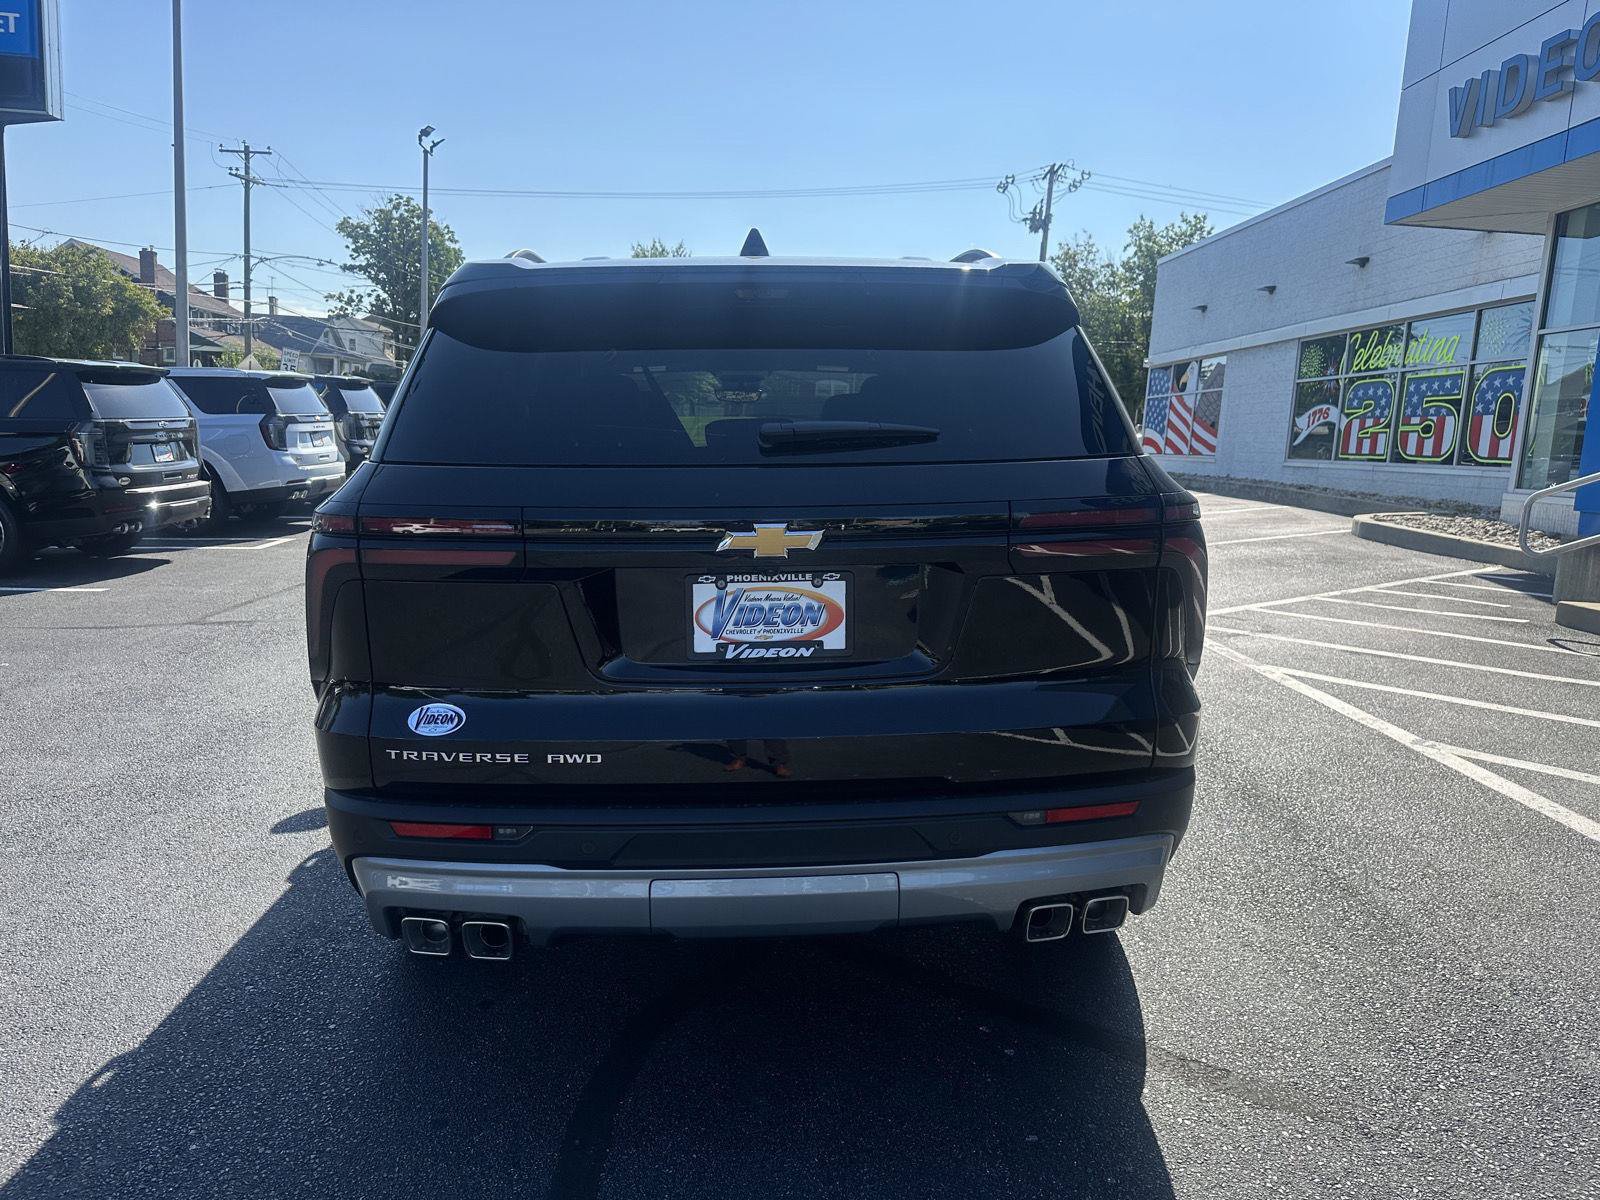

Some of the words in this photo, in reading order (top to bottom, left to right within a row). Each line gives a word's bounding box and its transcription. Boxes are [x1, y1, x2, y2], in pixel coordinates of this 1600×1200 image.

[1339, 329, 1461, 380] Celebrating
[1306, 406, 1330, 430] 1776
[1338, 365, 1527, 464] 250
[726, 573, 813, 582] PHOENIXVILLE
[763, 593, 782, 602] Means
[711, 587, 825, 640] VIDEON
[762, 627, 804, 635] PHOENIXVILLE
[725, 643, 814, 659] VIDEON
[414, 706, 456, 731] VIDEON
[385, 749, 530, 763] TRAVERSE
[547, 753, 602, 764] AWD
